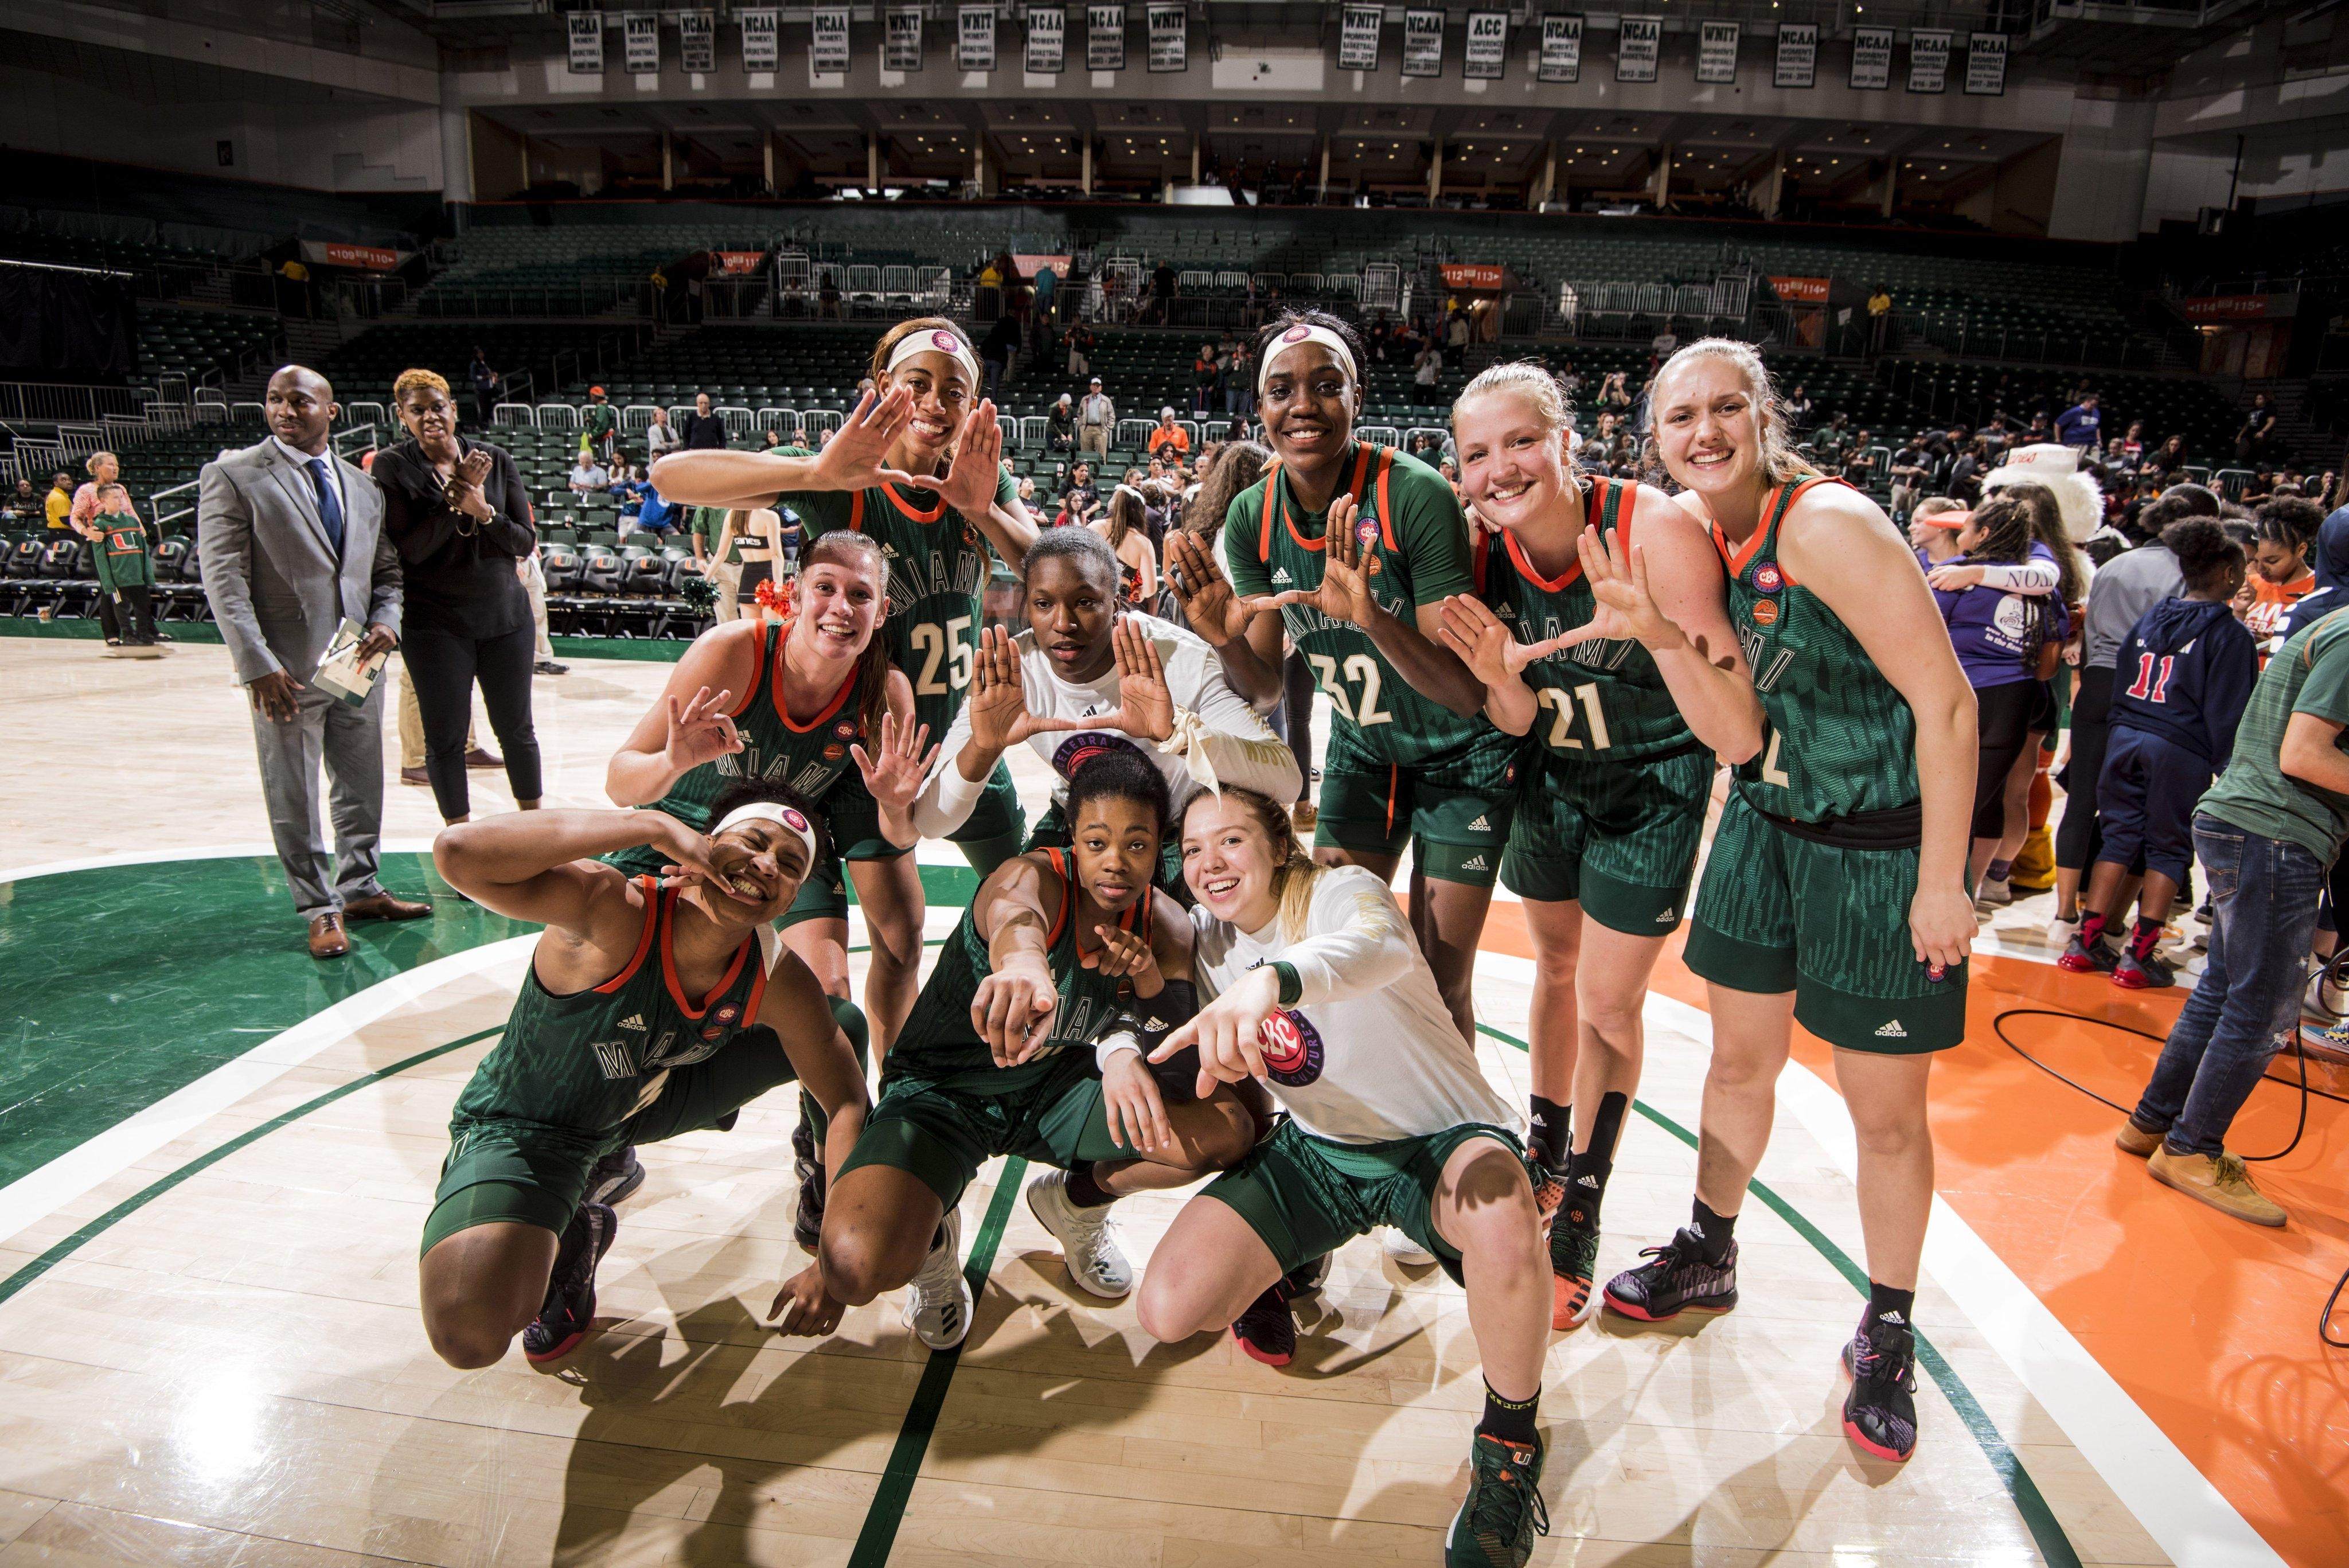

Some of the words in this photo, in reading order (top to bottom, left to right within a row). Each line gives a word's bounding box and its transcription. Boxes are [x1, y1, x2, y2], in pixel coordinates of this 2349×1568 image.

[571, 18, 598, 34] NCAA
[682, 16, 712, 33] NCAA
[745, 16, 775, 33] NCAA
[815, 16, 846, 32] NCAA
[888, 14, 919, 30] WNIT
[962, 13, 992, 30] WNIT
[1031, 14, 1062, 30] NCAA
[1090, 11, 1122, 28] NCAA
[1150, 12, 1184, 29] WNIT
[1345, 12, 1379, 29] WNIT
[1408, 16, 1441, 33] NCAA
[1473, 18, 1501, 36] ACC
[1546, 22, 1579, 40] NCAA
[1623, 24, 1657, 41] NCAA
[1704, 26, 1737, 42] WNIT
[1781, 31, 1815, 45] NCAA
[1857, 36, 1890, 50] NCAA
[1914, 38, 1948, 52] NCAA
[1972, 40, 2005, 53] NCAA
[337, 250, 355, 260] 109
[370, 253, 388, 264] 110
[1446, 271, 1462, 280] 112
[1477, 271, 1493, 281] 113
[1803, 284, 1820, 294] 114
[1519, 617, 1636, 670] IAMI
[911, 615, 973, 695] 25
[2125, 652, 2175, 703] 11
[1309, 653, 1393, 727] 32
[1536, 682, 1611, 751] 21
[838, 726, 852, 735] CBC
[1462, 863, 1489, 871] adidas
[719, 1008, 735, 1019] CBC
[617, 1022, 647, 1031] adidas
[1144, 1023, 1169, 1032] adidas
[1290, 1029, 1320, 1084] CULTURE
[1578, 1179, 1599, 1189] adidas
[1879, 1314, 1905, 1324] adidas
[1513, 1452, 1531, 1465] U
